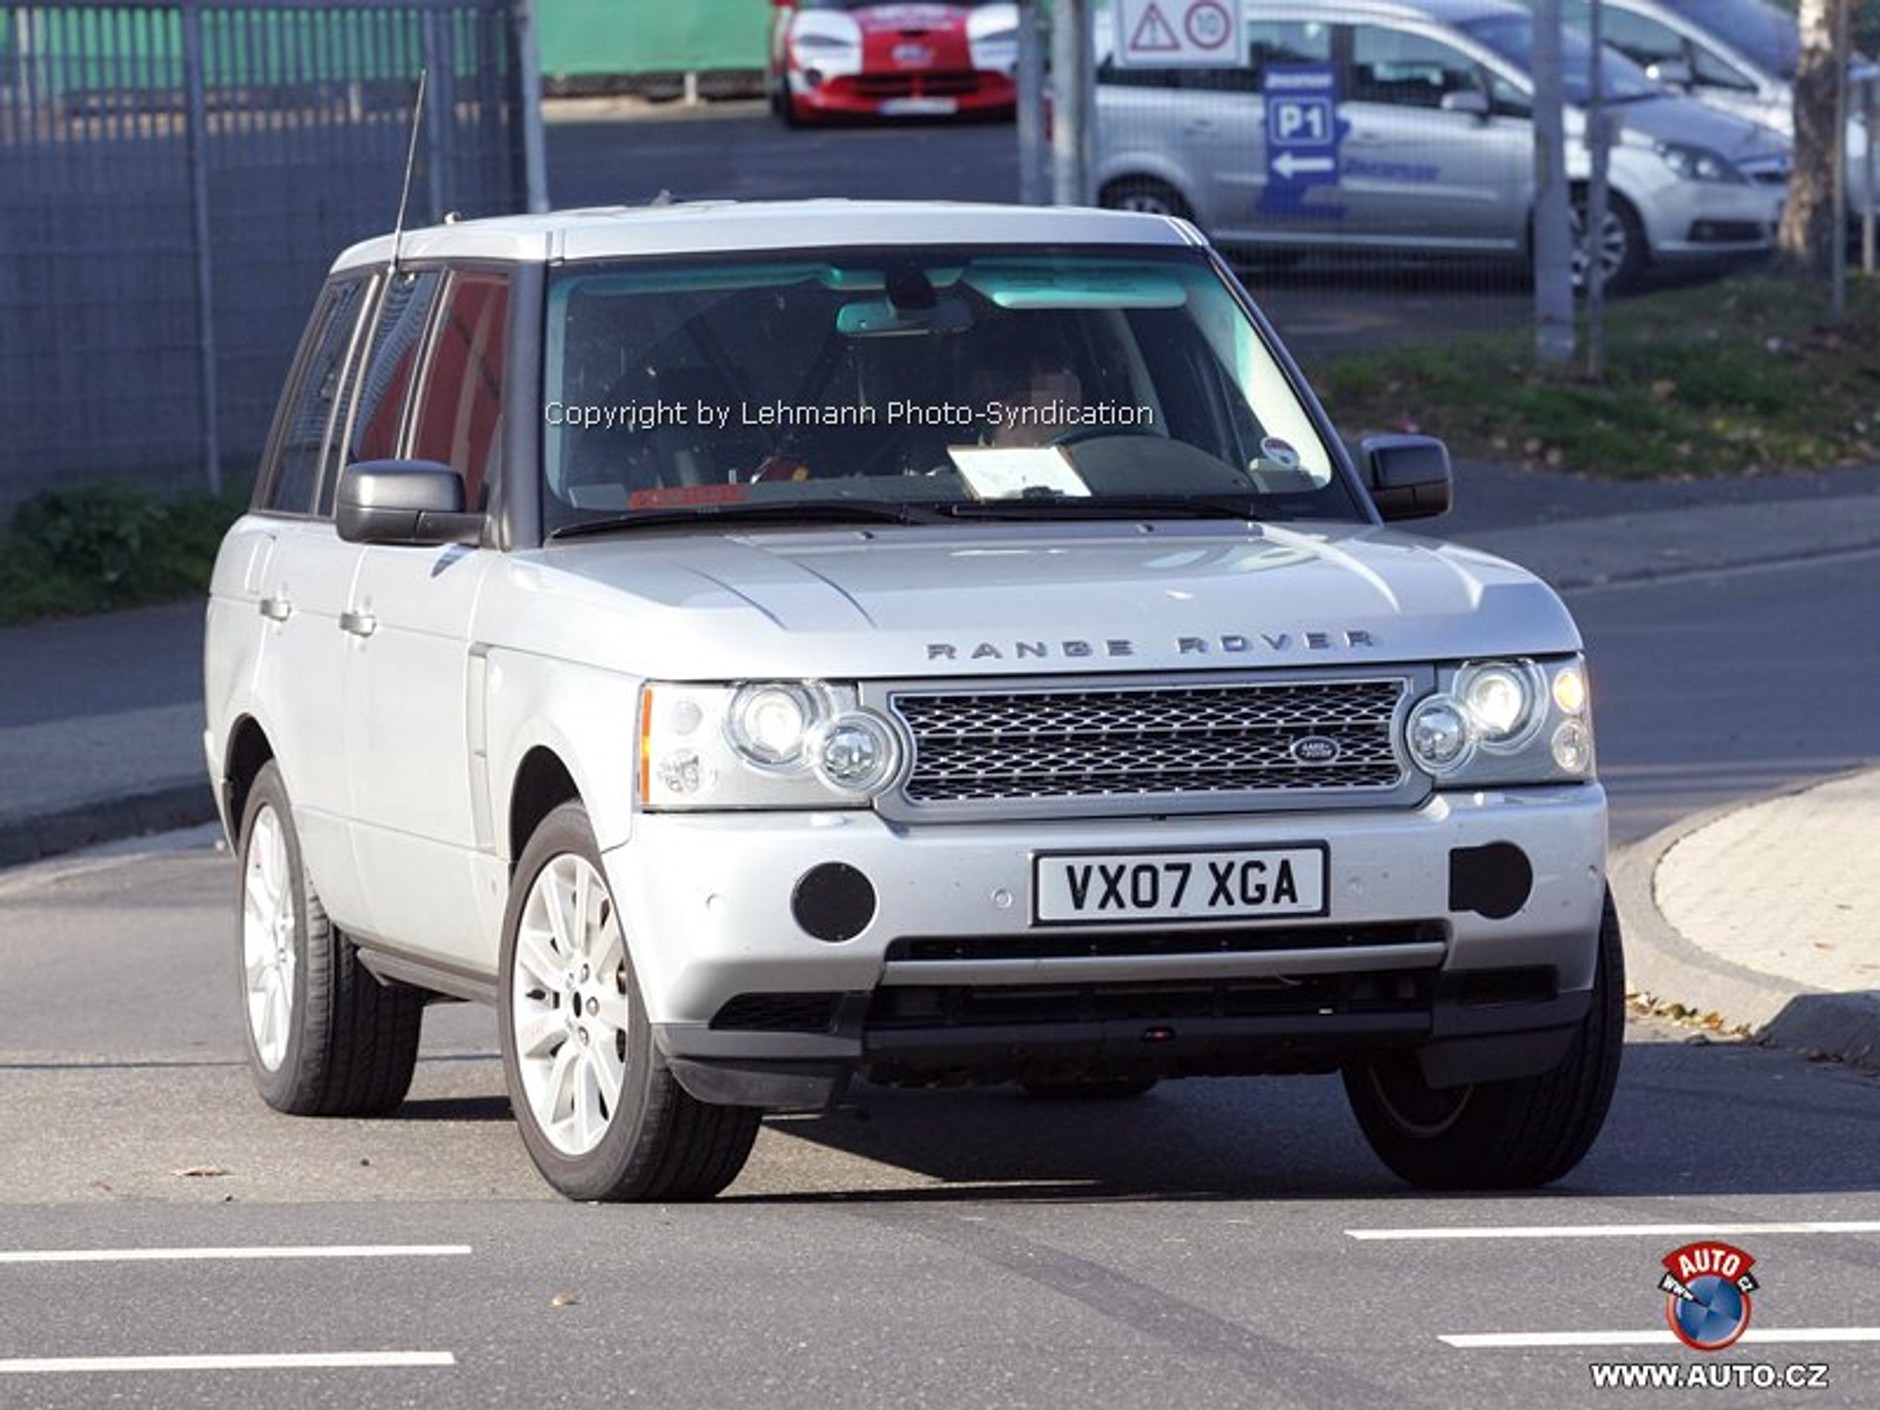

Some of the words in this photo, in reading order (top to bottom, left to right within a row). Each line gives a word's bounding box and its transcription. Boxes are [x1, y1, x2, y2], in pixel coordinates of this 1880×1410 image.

[1278, 104, 1325, 138] P1
[926, 638, 1136, 661] RANGE
[1176, 630, 1376, 655] ROVER
[1066, 863, 1193, 911] VX07
[1207, 859, 1299, 907] XGA
